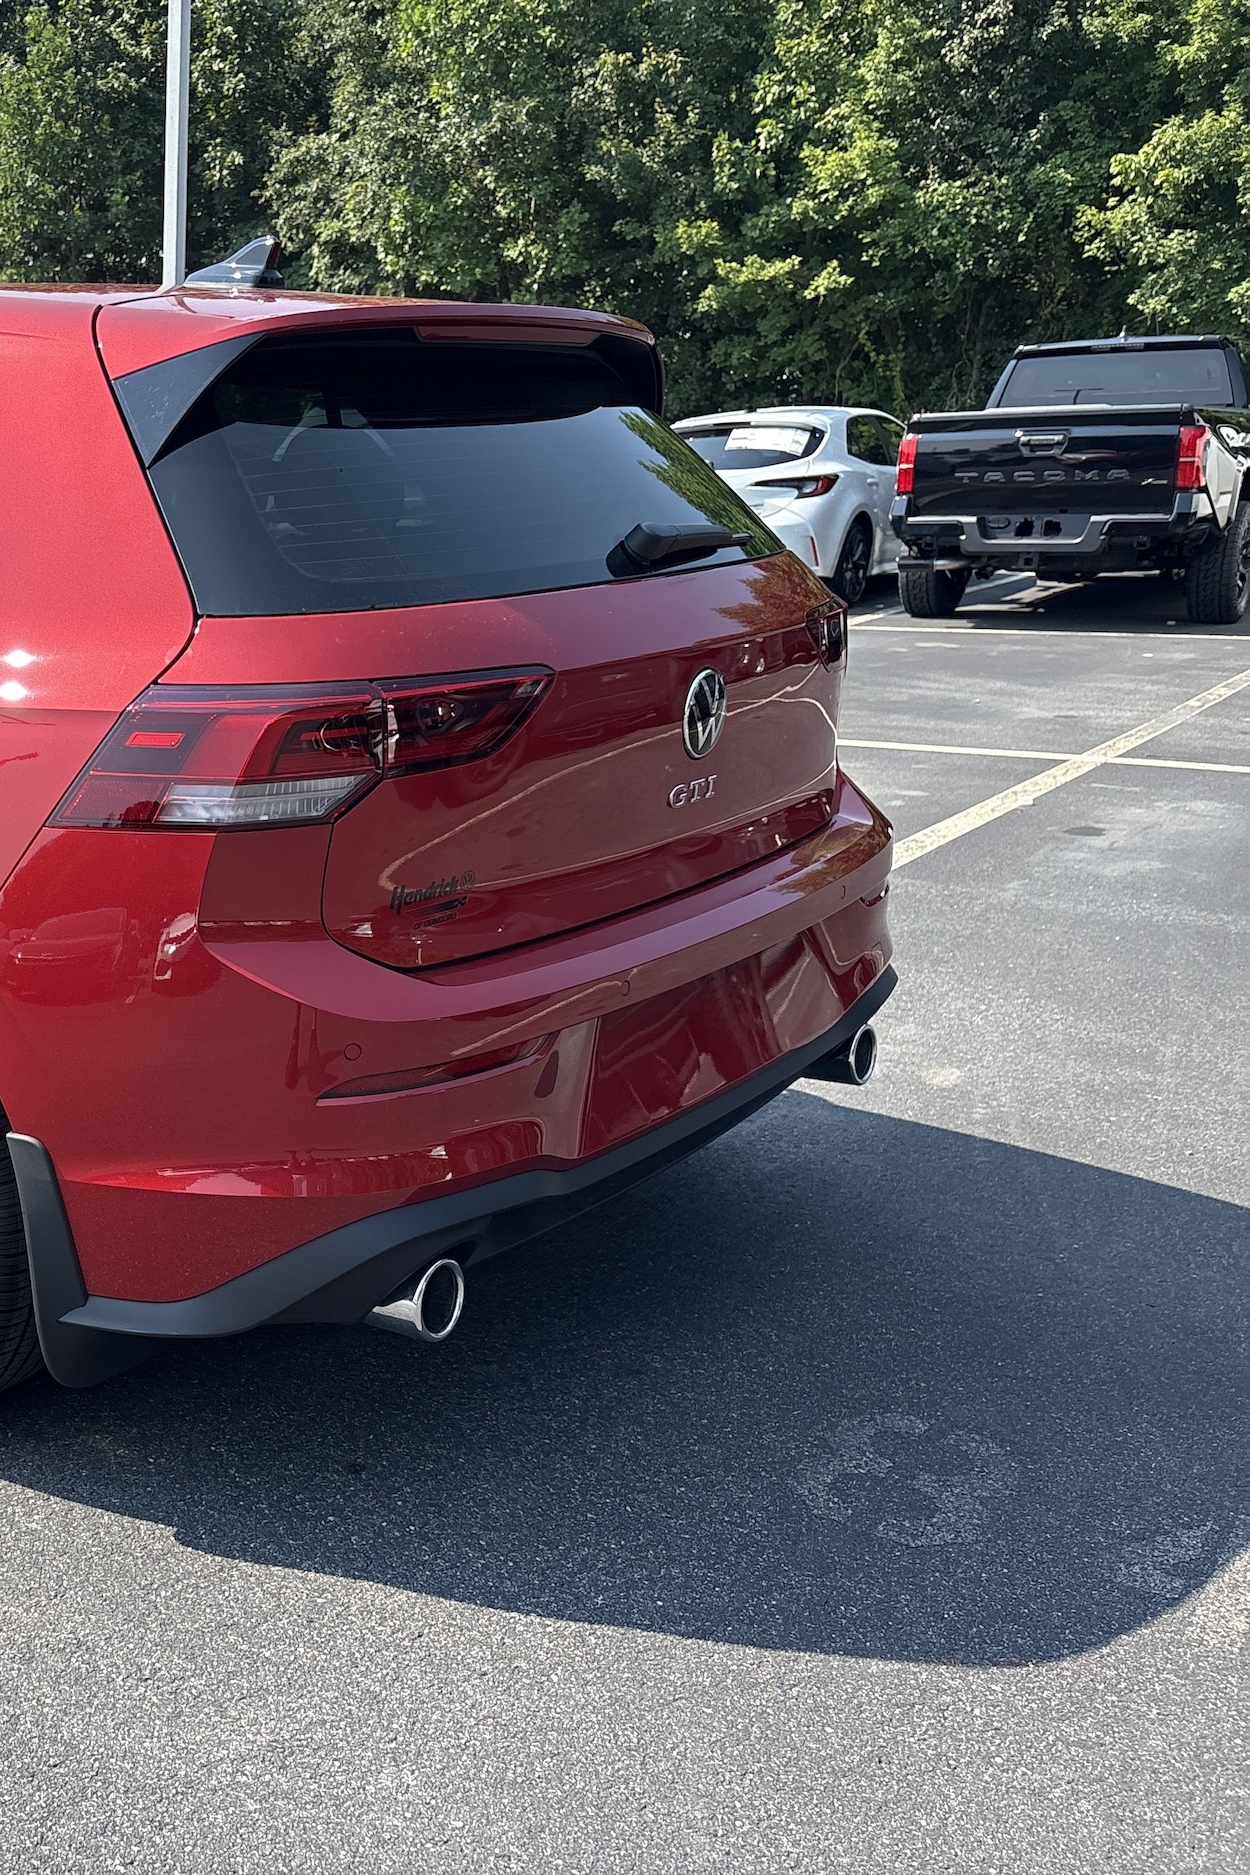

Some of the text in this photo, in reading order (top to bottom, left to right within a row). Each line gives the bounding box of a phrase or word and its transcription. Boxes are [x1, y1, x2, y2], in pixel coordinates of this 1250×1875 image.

[954, 468, 1131, 483] TACOMA
[667, 774, 718, 809] GTI
[390, 876, 458, 916] Hendrick
